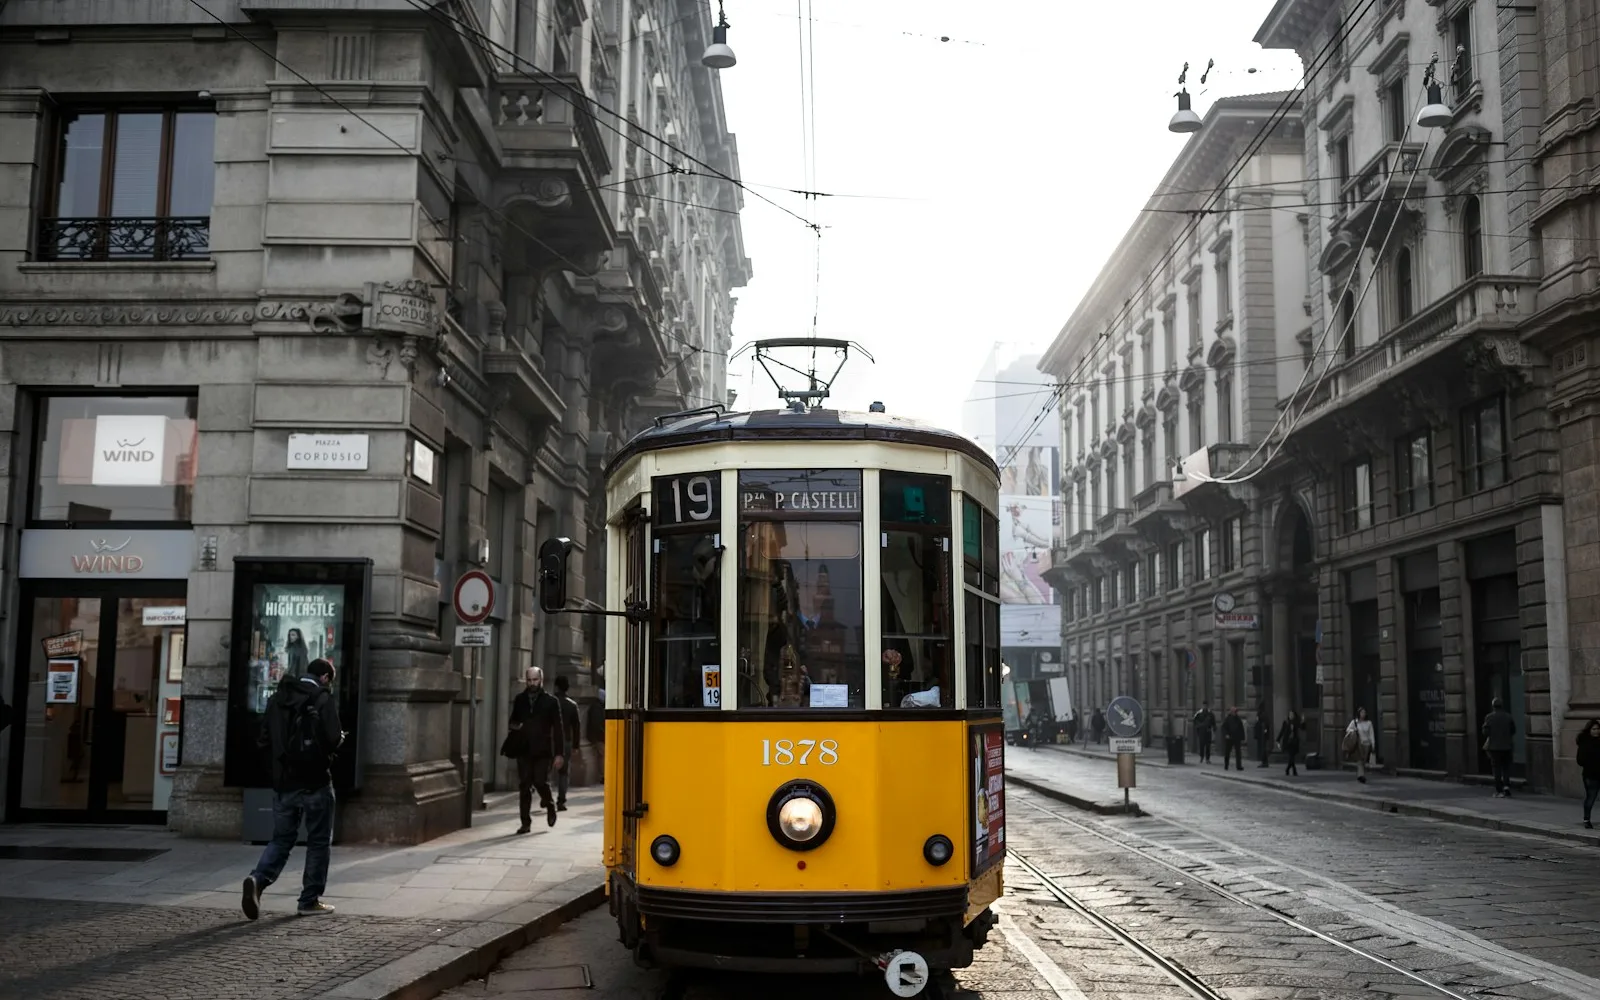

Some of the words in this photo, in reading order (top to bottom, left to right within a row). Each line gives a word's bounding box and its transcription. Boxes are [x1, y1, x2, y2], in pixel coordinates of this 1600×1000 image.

[315, 439, 341, 447] PIAZZA
[103, 450, 155, 462] WIND
[294, 452, 362, 461] CORDUSIO
[671, 475, 713, 523] 19
[775, 491, 785, 509] P.
[791, 491, 858, 509] CASTELLI
[71, 554, 144, 574] WIND
[265, 602, 293, 617] HIGH
[295, 602, 336, 617] CASTLE
[706, 673, 719, 687] 51
[707, 689, 719, 704] 19
[761, 739, 839, 766] 1878
